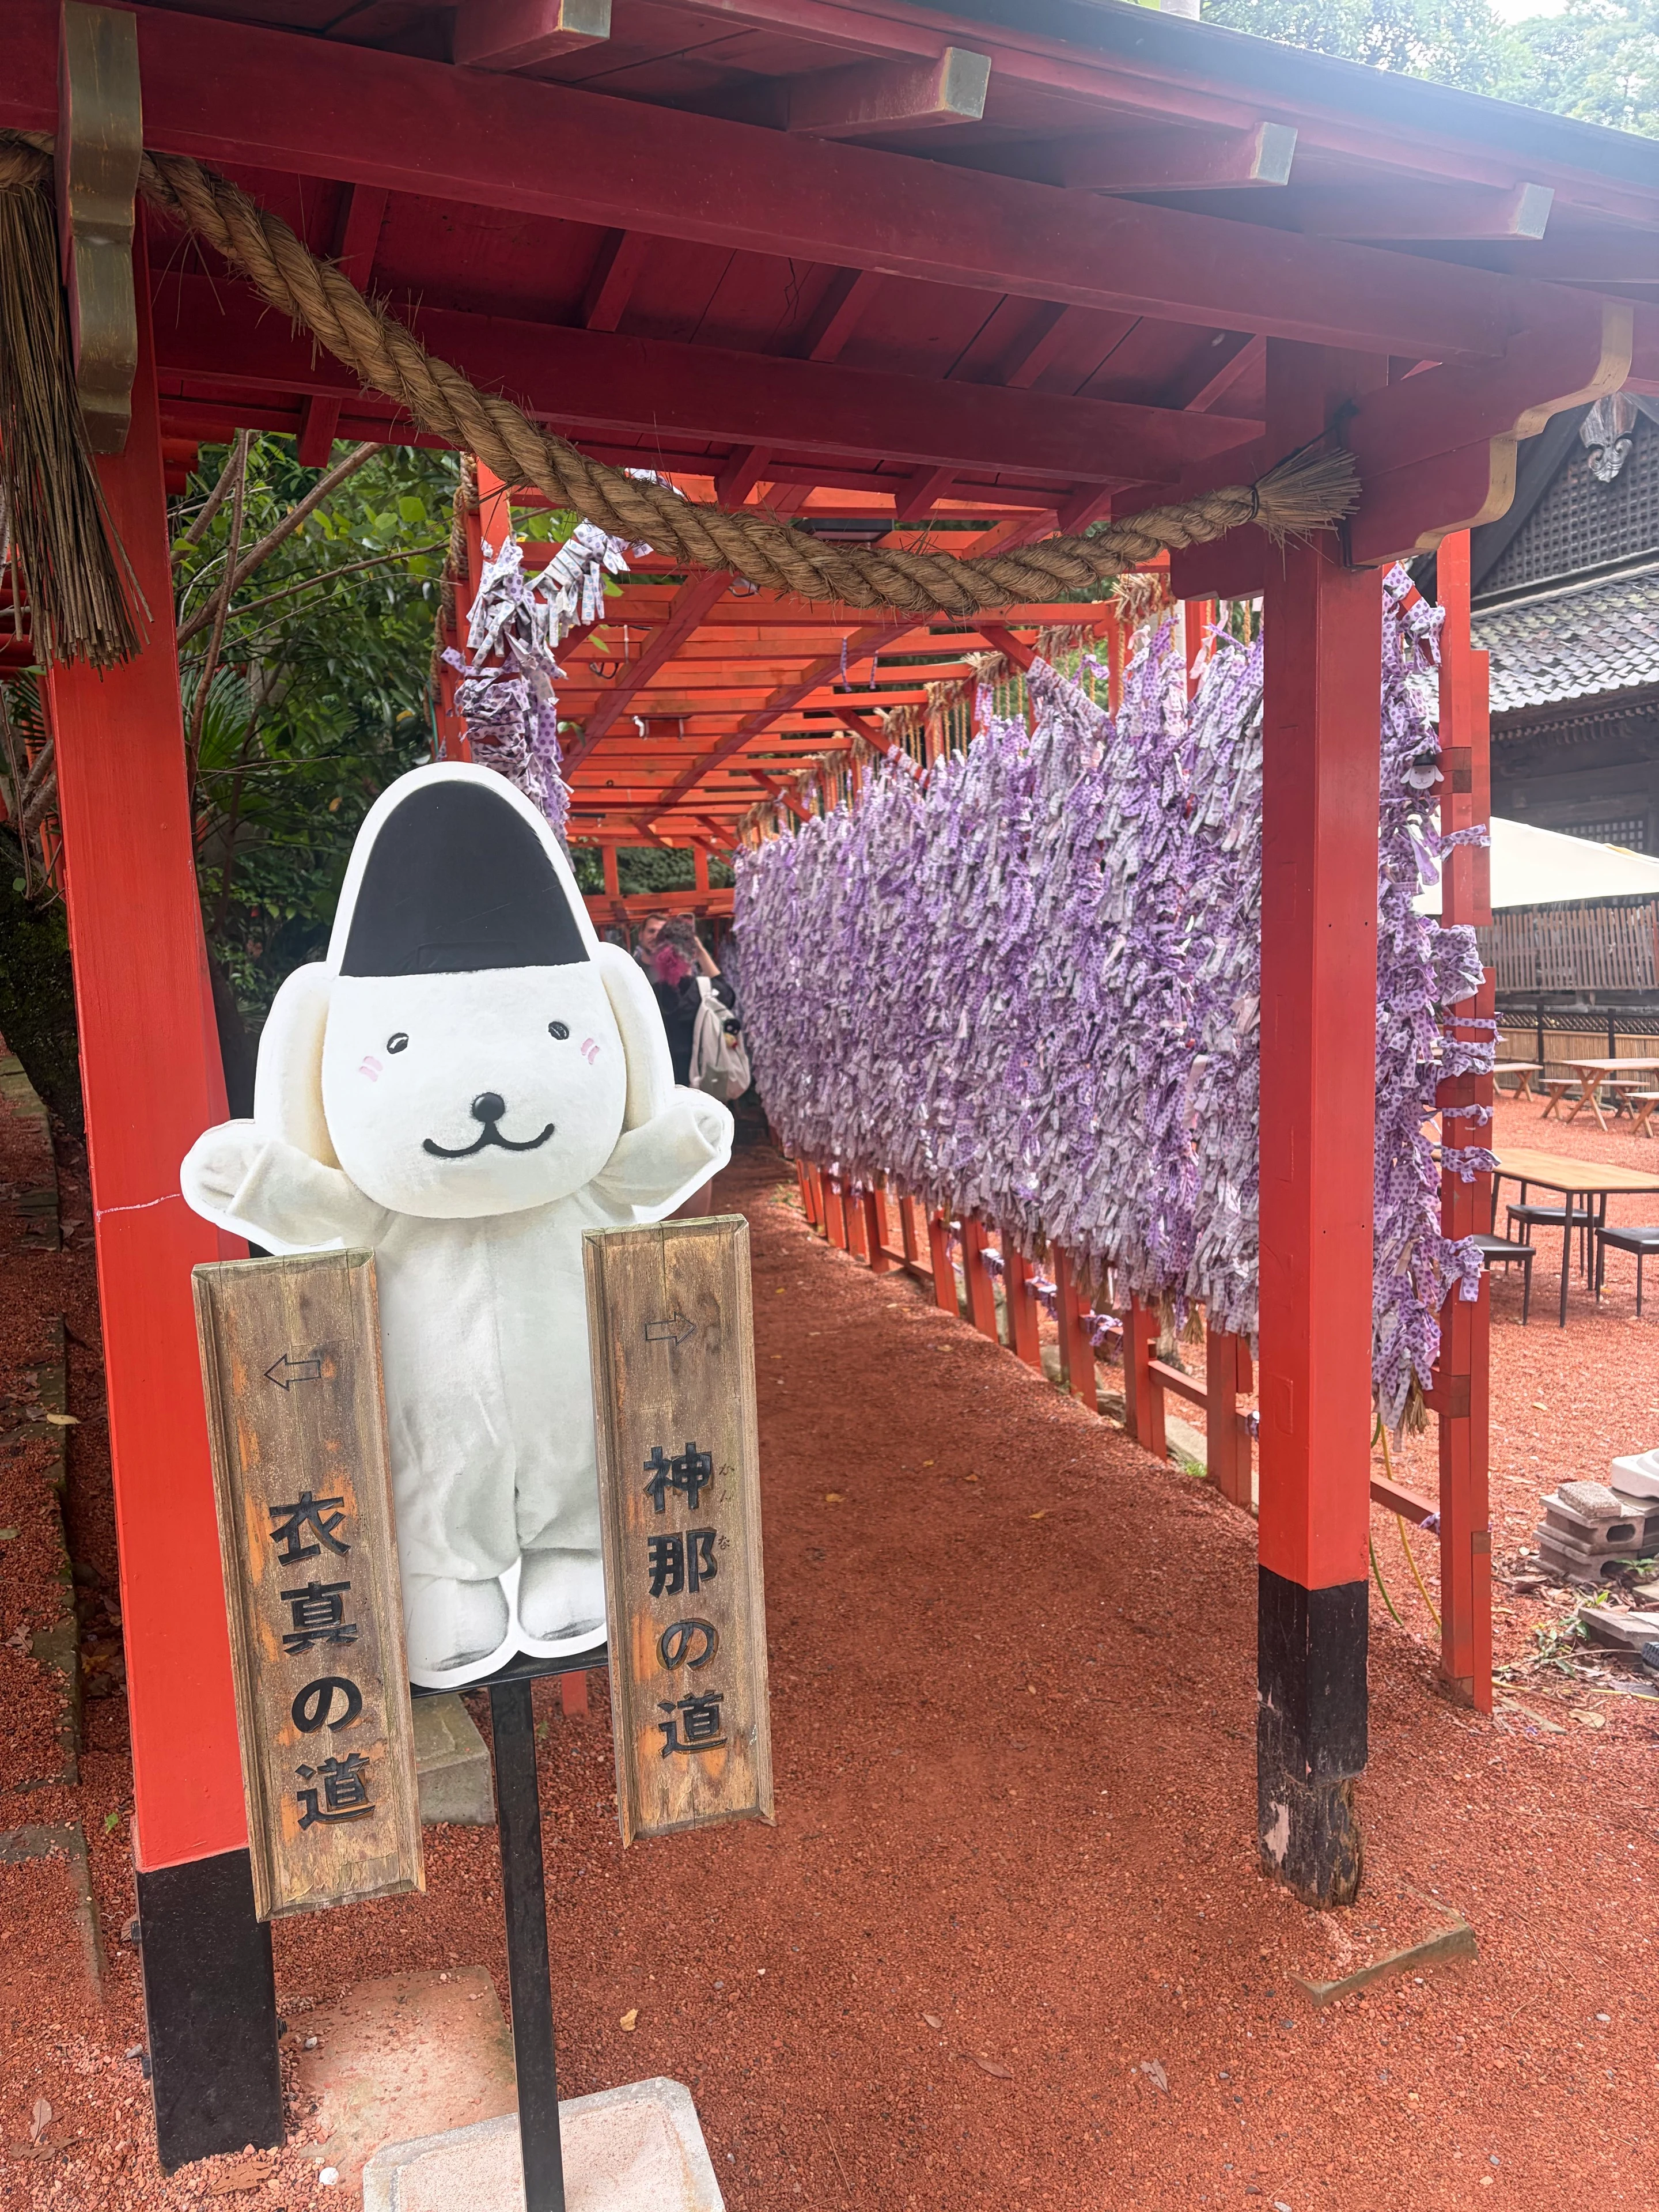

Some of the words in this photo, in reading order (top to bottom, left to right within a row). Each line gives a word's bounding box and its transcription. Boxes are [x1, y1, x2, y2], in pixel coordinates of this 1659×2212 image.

[269, 1491, 375, 1831] 衣真の道
[643, 1442, 727, 1759] 神那の道
